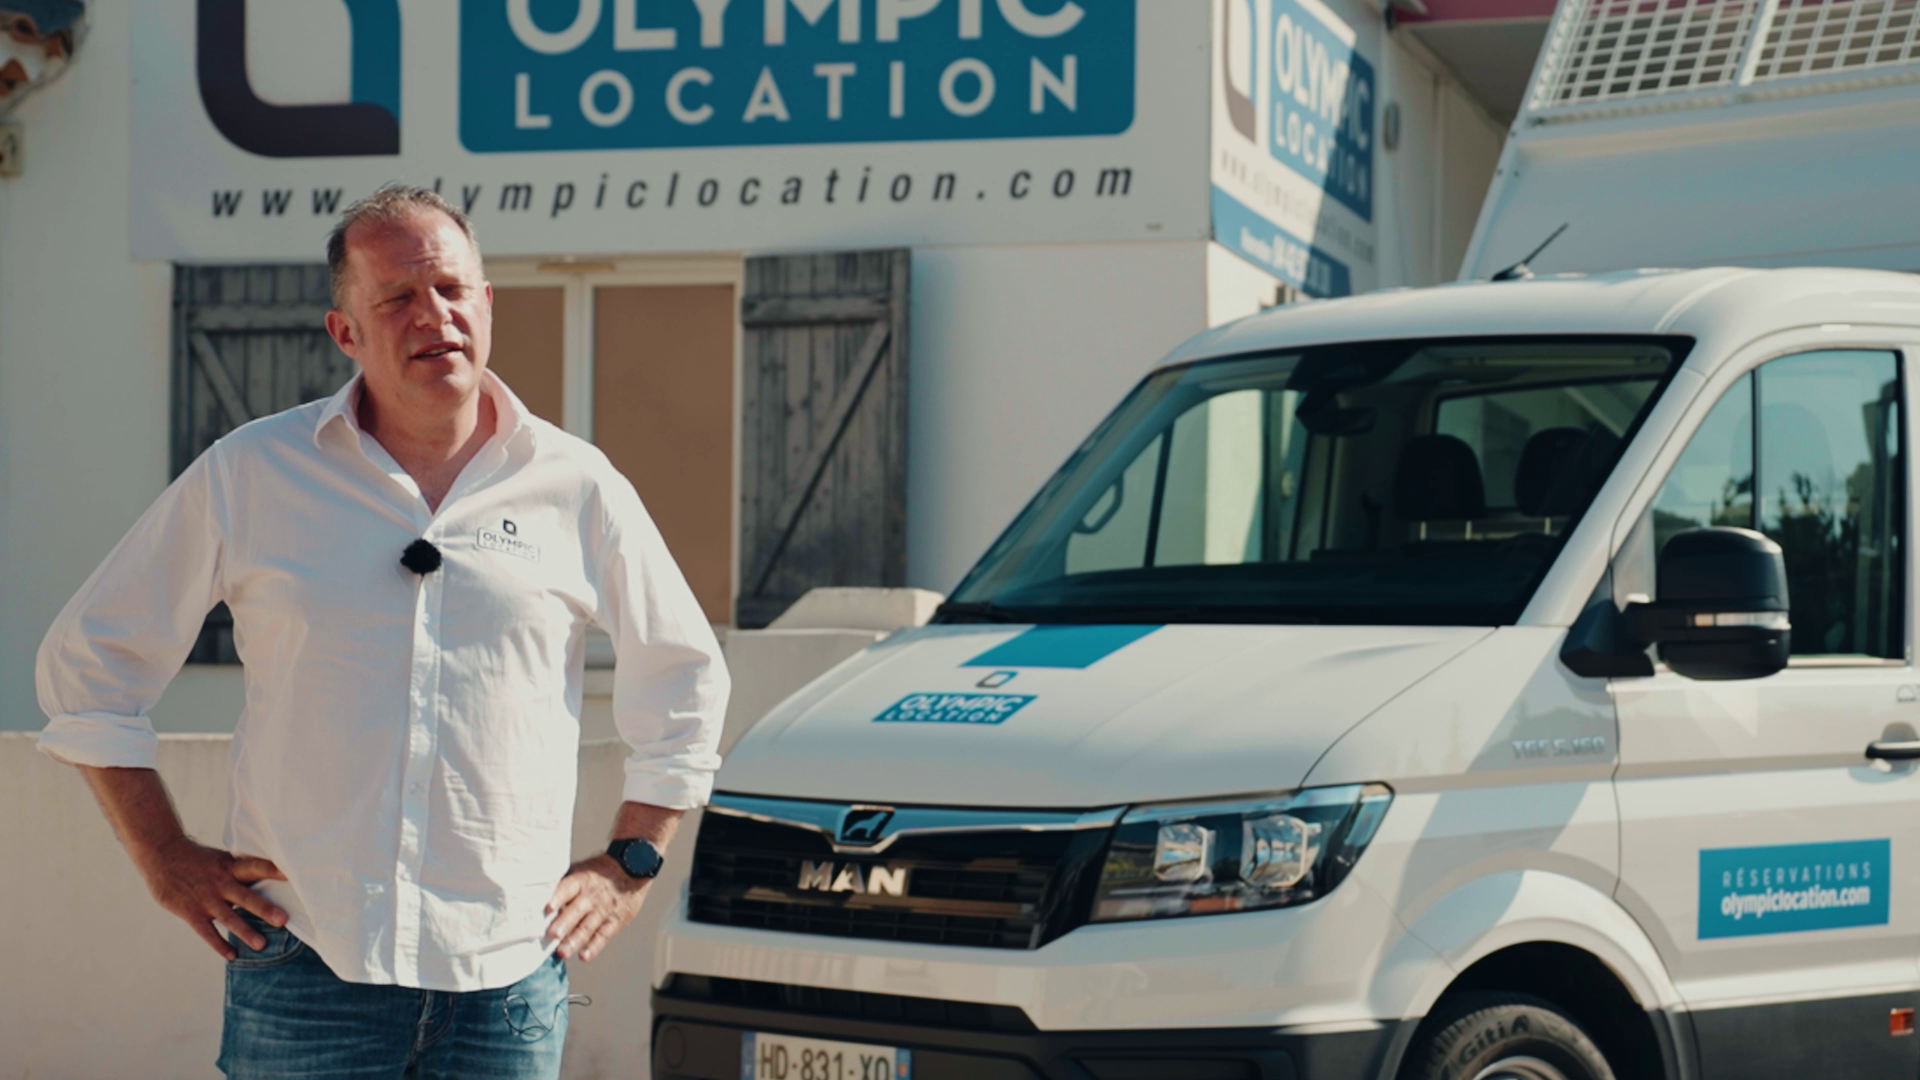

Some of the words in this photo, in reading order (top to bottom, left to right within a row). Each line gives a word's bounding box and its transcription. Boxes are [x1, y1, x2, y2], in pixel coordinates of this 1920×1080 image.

[515, 55, 1077, 129] LOCATION
[884, 709, 1003, 722] LOCATION
[900, 695, 1024, 712] OLYMPIC
[798, 860, 906, 896] MAN
[1723, 861, 1871, 888] RÉSERVATIONS
[1721, 884, 1871, 920] olympiclocation.com
